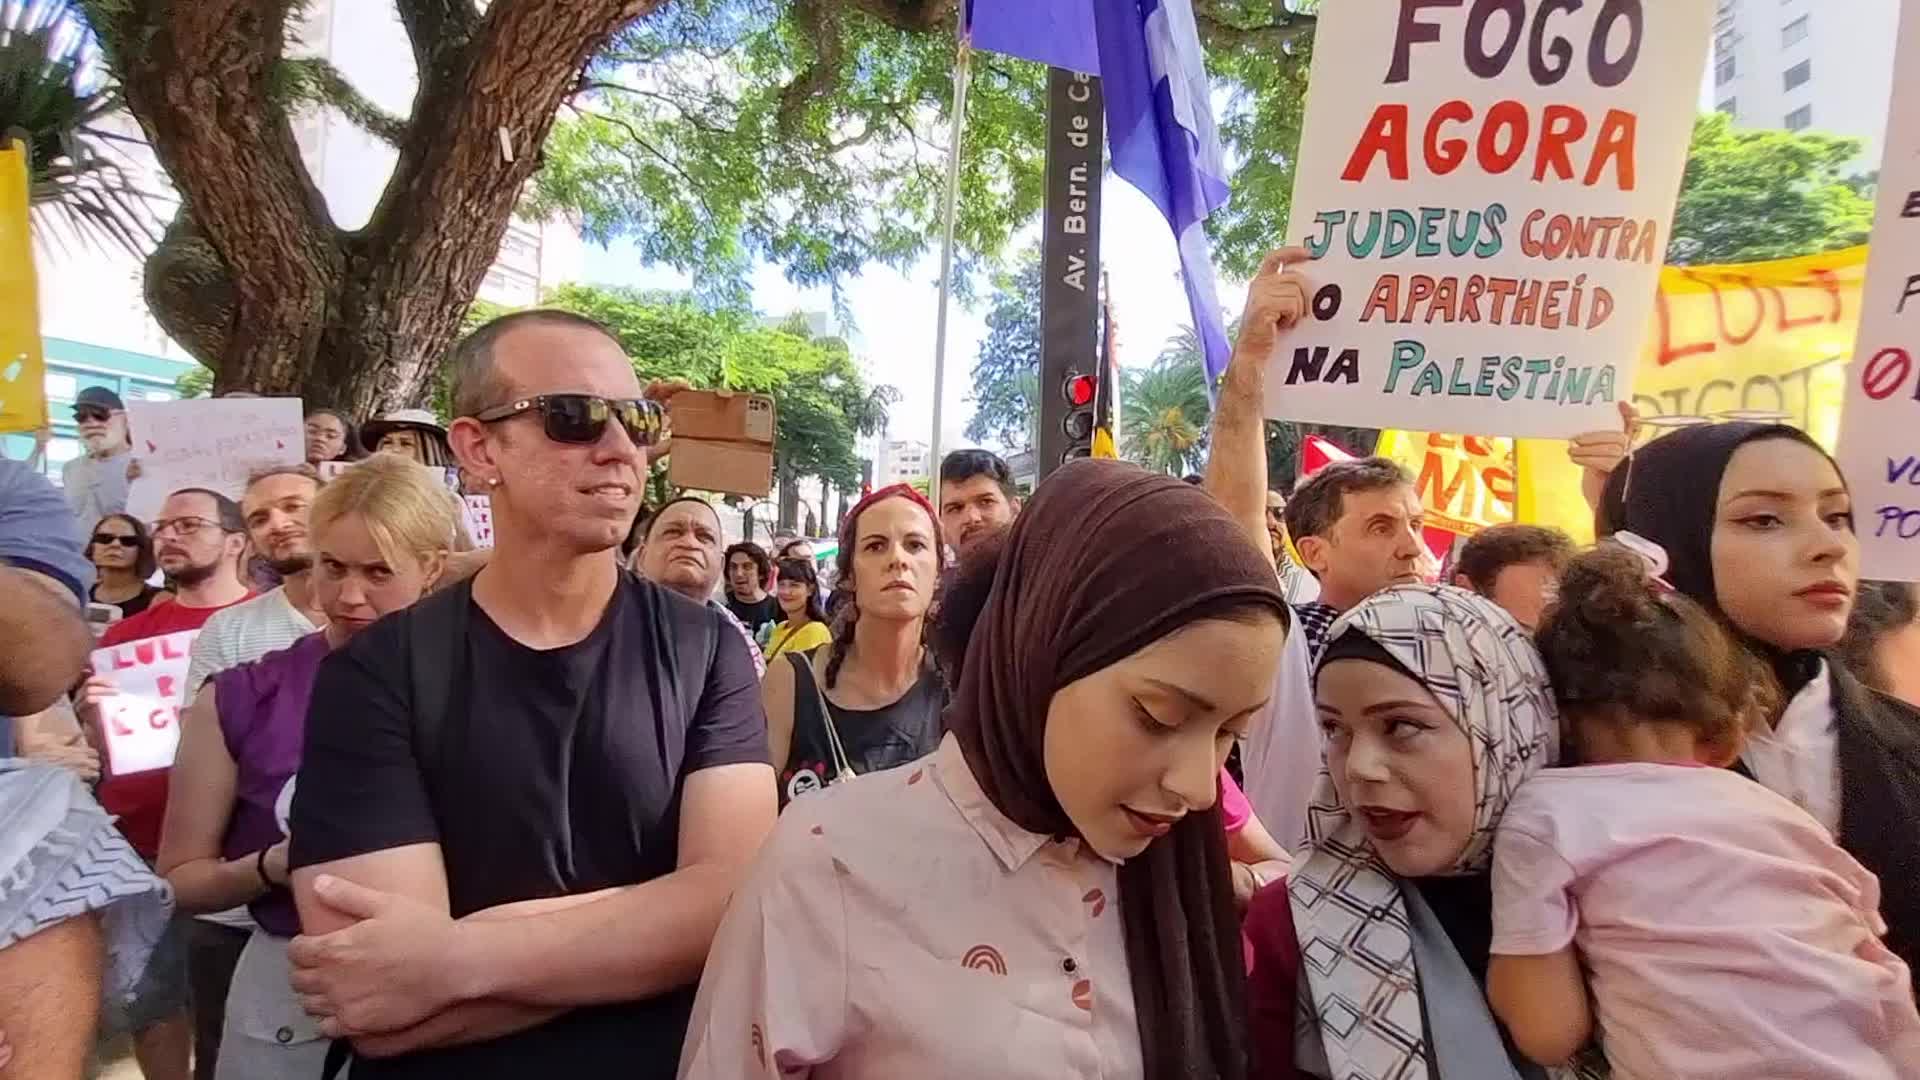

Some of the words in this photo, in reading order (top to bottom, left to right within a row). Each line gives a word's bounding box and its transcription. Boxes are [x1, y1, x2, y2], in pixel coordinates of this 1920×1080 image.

[1384, 0, 1644, 87] FOGO
[1067, 114, 1088, 148] de
[1341, 100, 1638, 191] AGORA
[1064, 161, 1087, 235] Bern.
[1303, 202, 1507, 261] JUDEUS
[1520, 208, 1656, 264] CONTRA
[1063, 248, 1085, 291] Av.
[1311, 283, 1342, 321] O
[1284, 346, 1359, 385] NA
